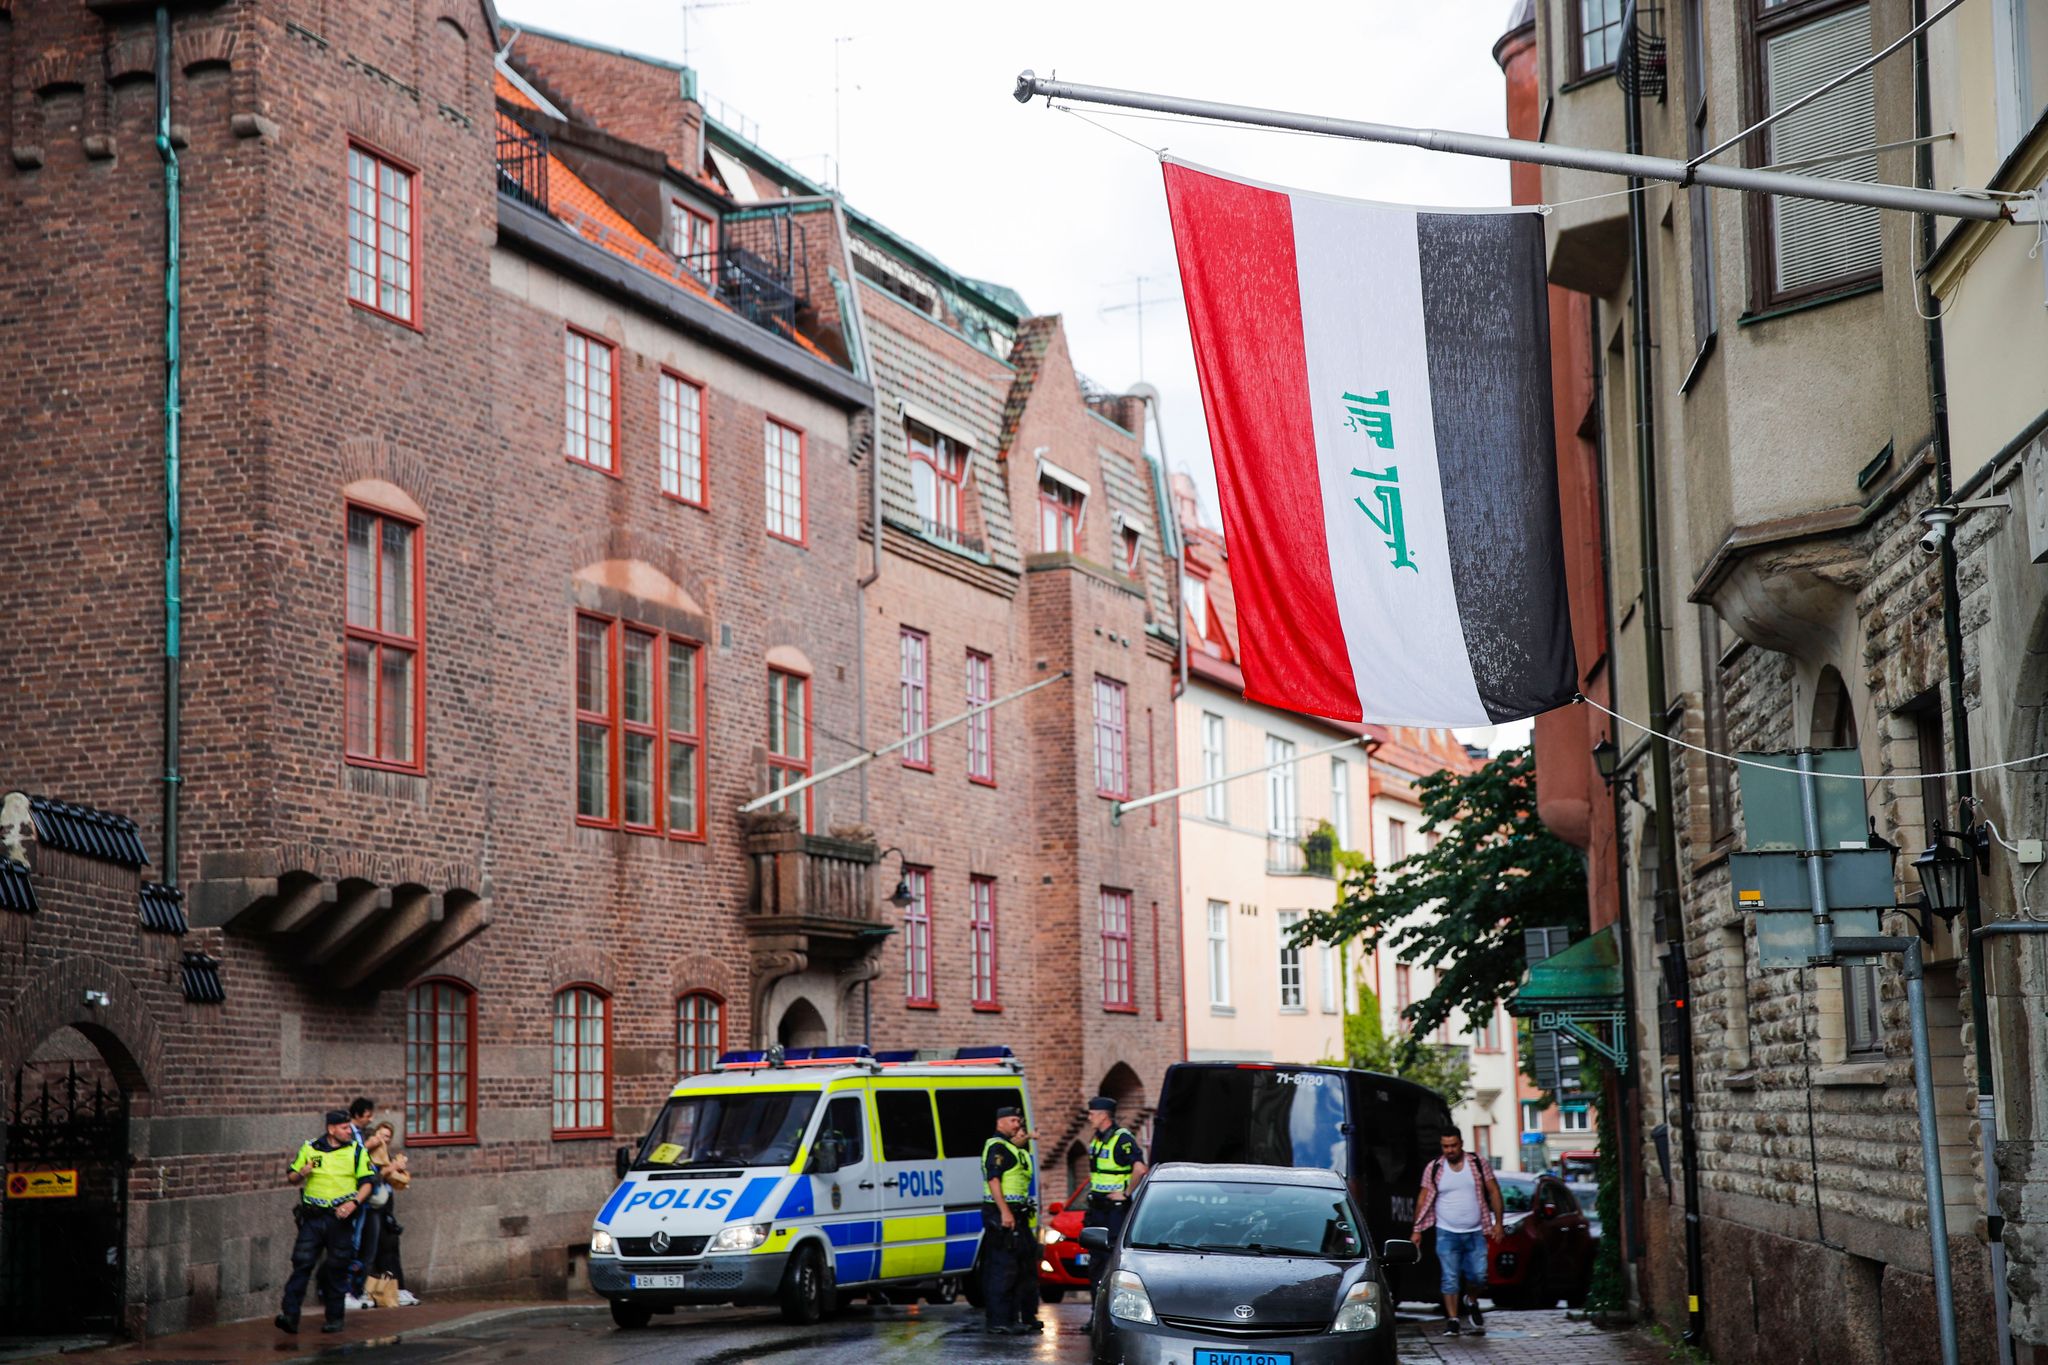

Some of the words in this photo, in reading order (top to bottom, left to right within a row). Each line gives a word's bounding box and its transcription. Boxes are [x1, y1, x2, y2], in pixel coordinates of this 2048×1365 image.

[1276, 1072, 1324, 1087] 71-8780
[899, 1169, 944, 1198] POLIS
[623, 1188, 734, 1213] POLIS
[663, 1276, 682, 1287] 157
